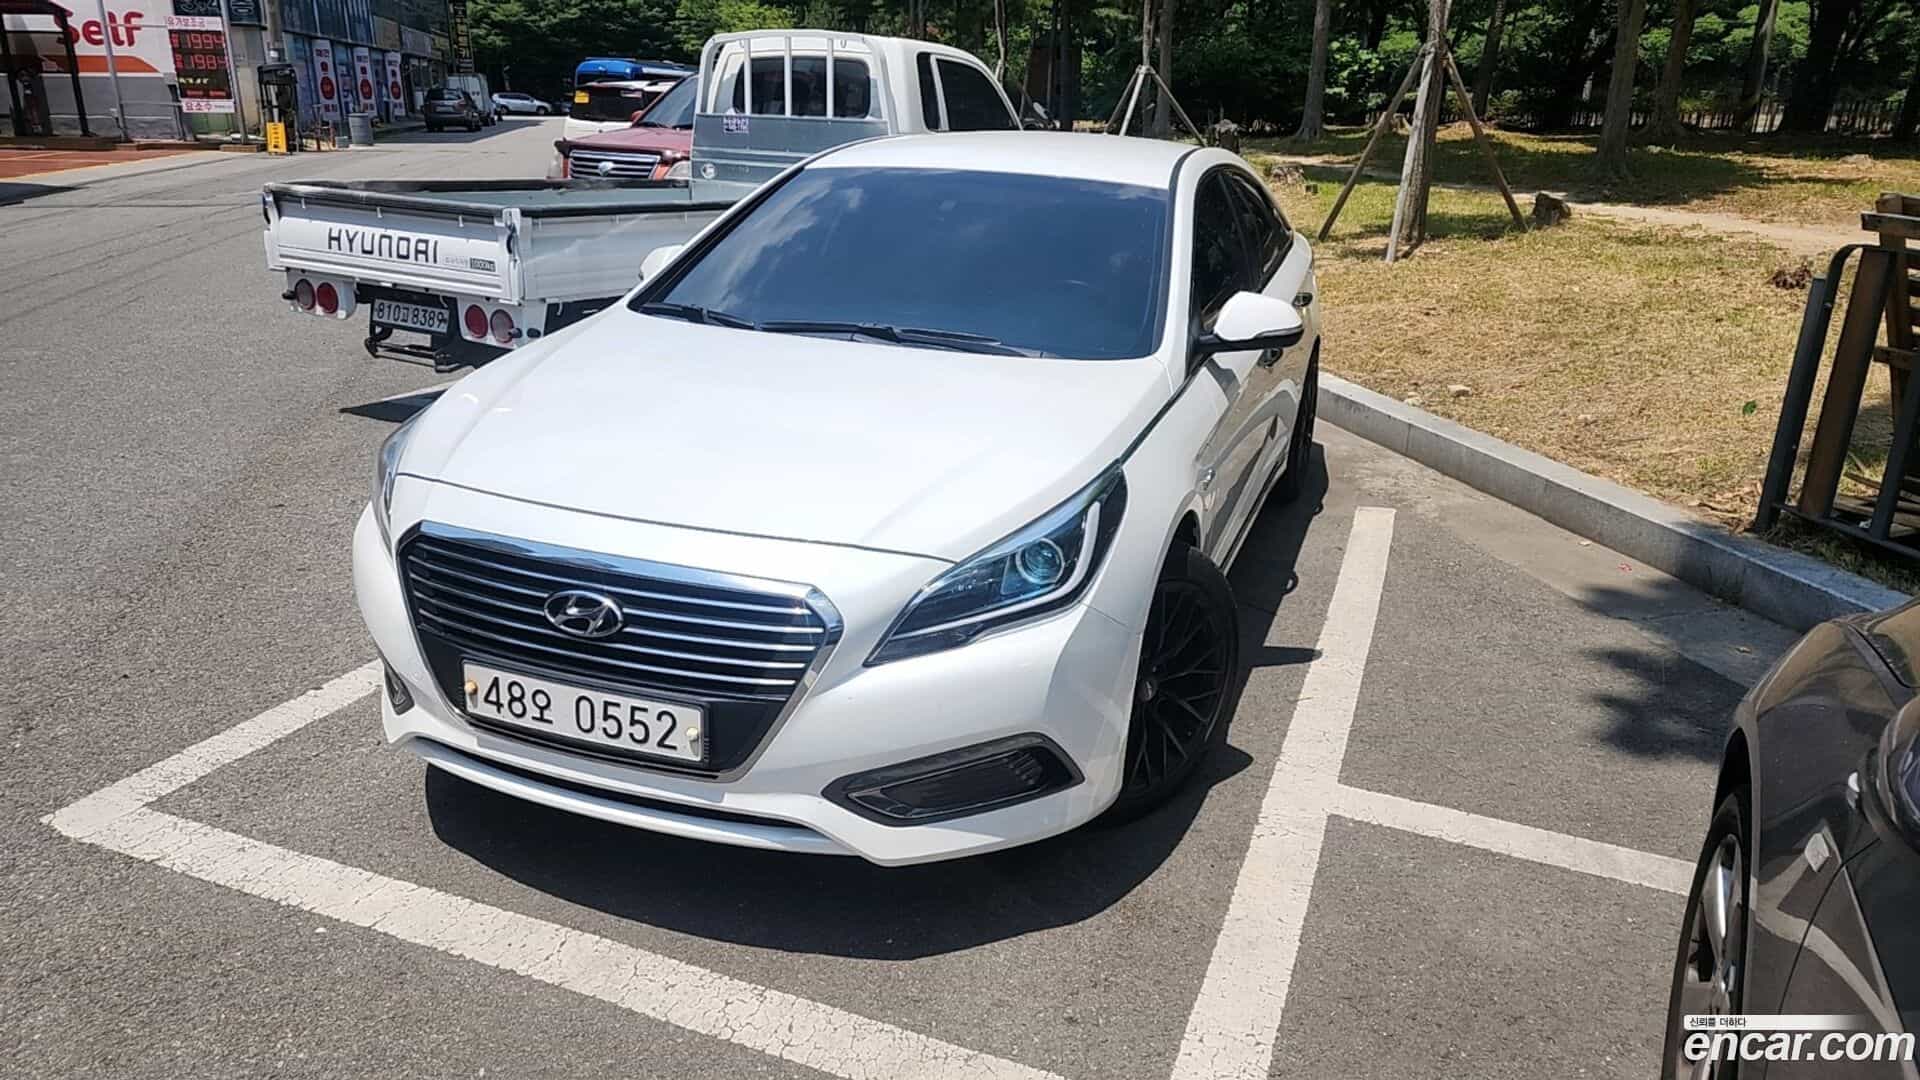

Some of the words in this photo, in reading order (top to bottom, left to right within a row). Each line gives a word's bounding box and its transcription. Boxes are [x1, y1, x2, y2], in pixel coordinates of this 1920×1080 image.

[328, 227, 438, 264] HYUNDAI
[483, 676, 553, 724] 48오
[575, 695, 678, 750] 0552
